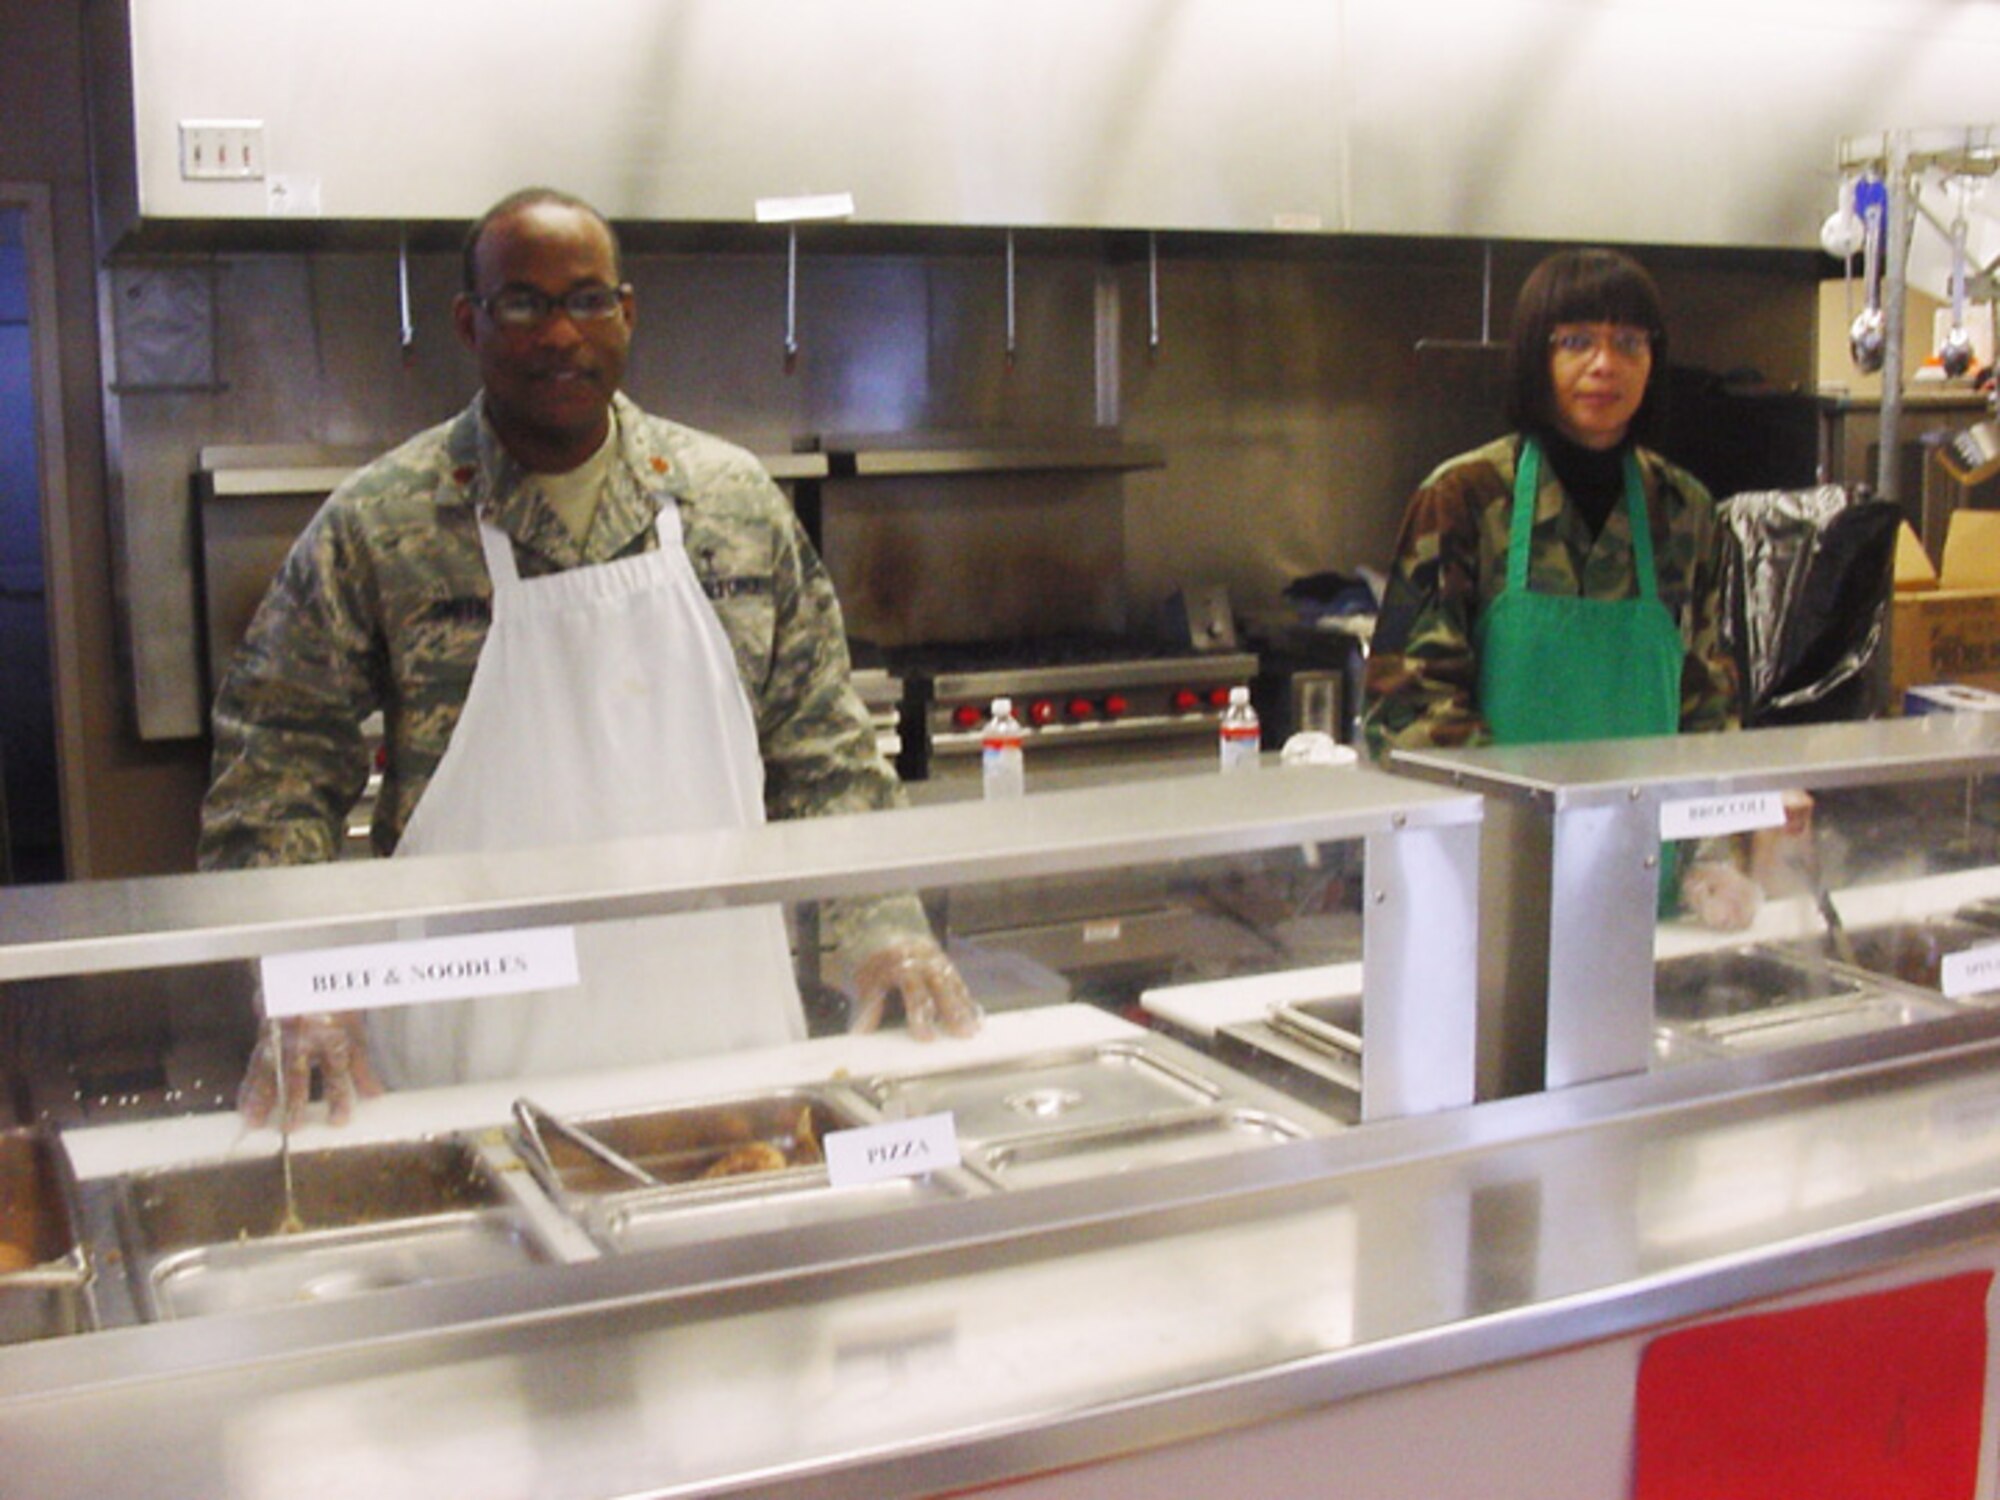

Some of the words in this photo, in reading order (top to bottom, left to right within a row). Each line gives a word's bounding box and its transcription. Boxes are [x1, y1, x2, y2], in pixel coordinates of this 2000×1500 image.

[312, 970, 371, 993] BEEF
[383, 968, 402, 986] &
[410, 955, 528, 981] NOODLES
[867, 1139, 930, 1164] PIZZA
